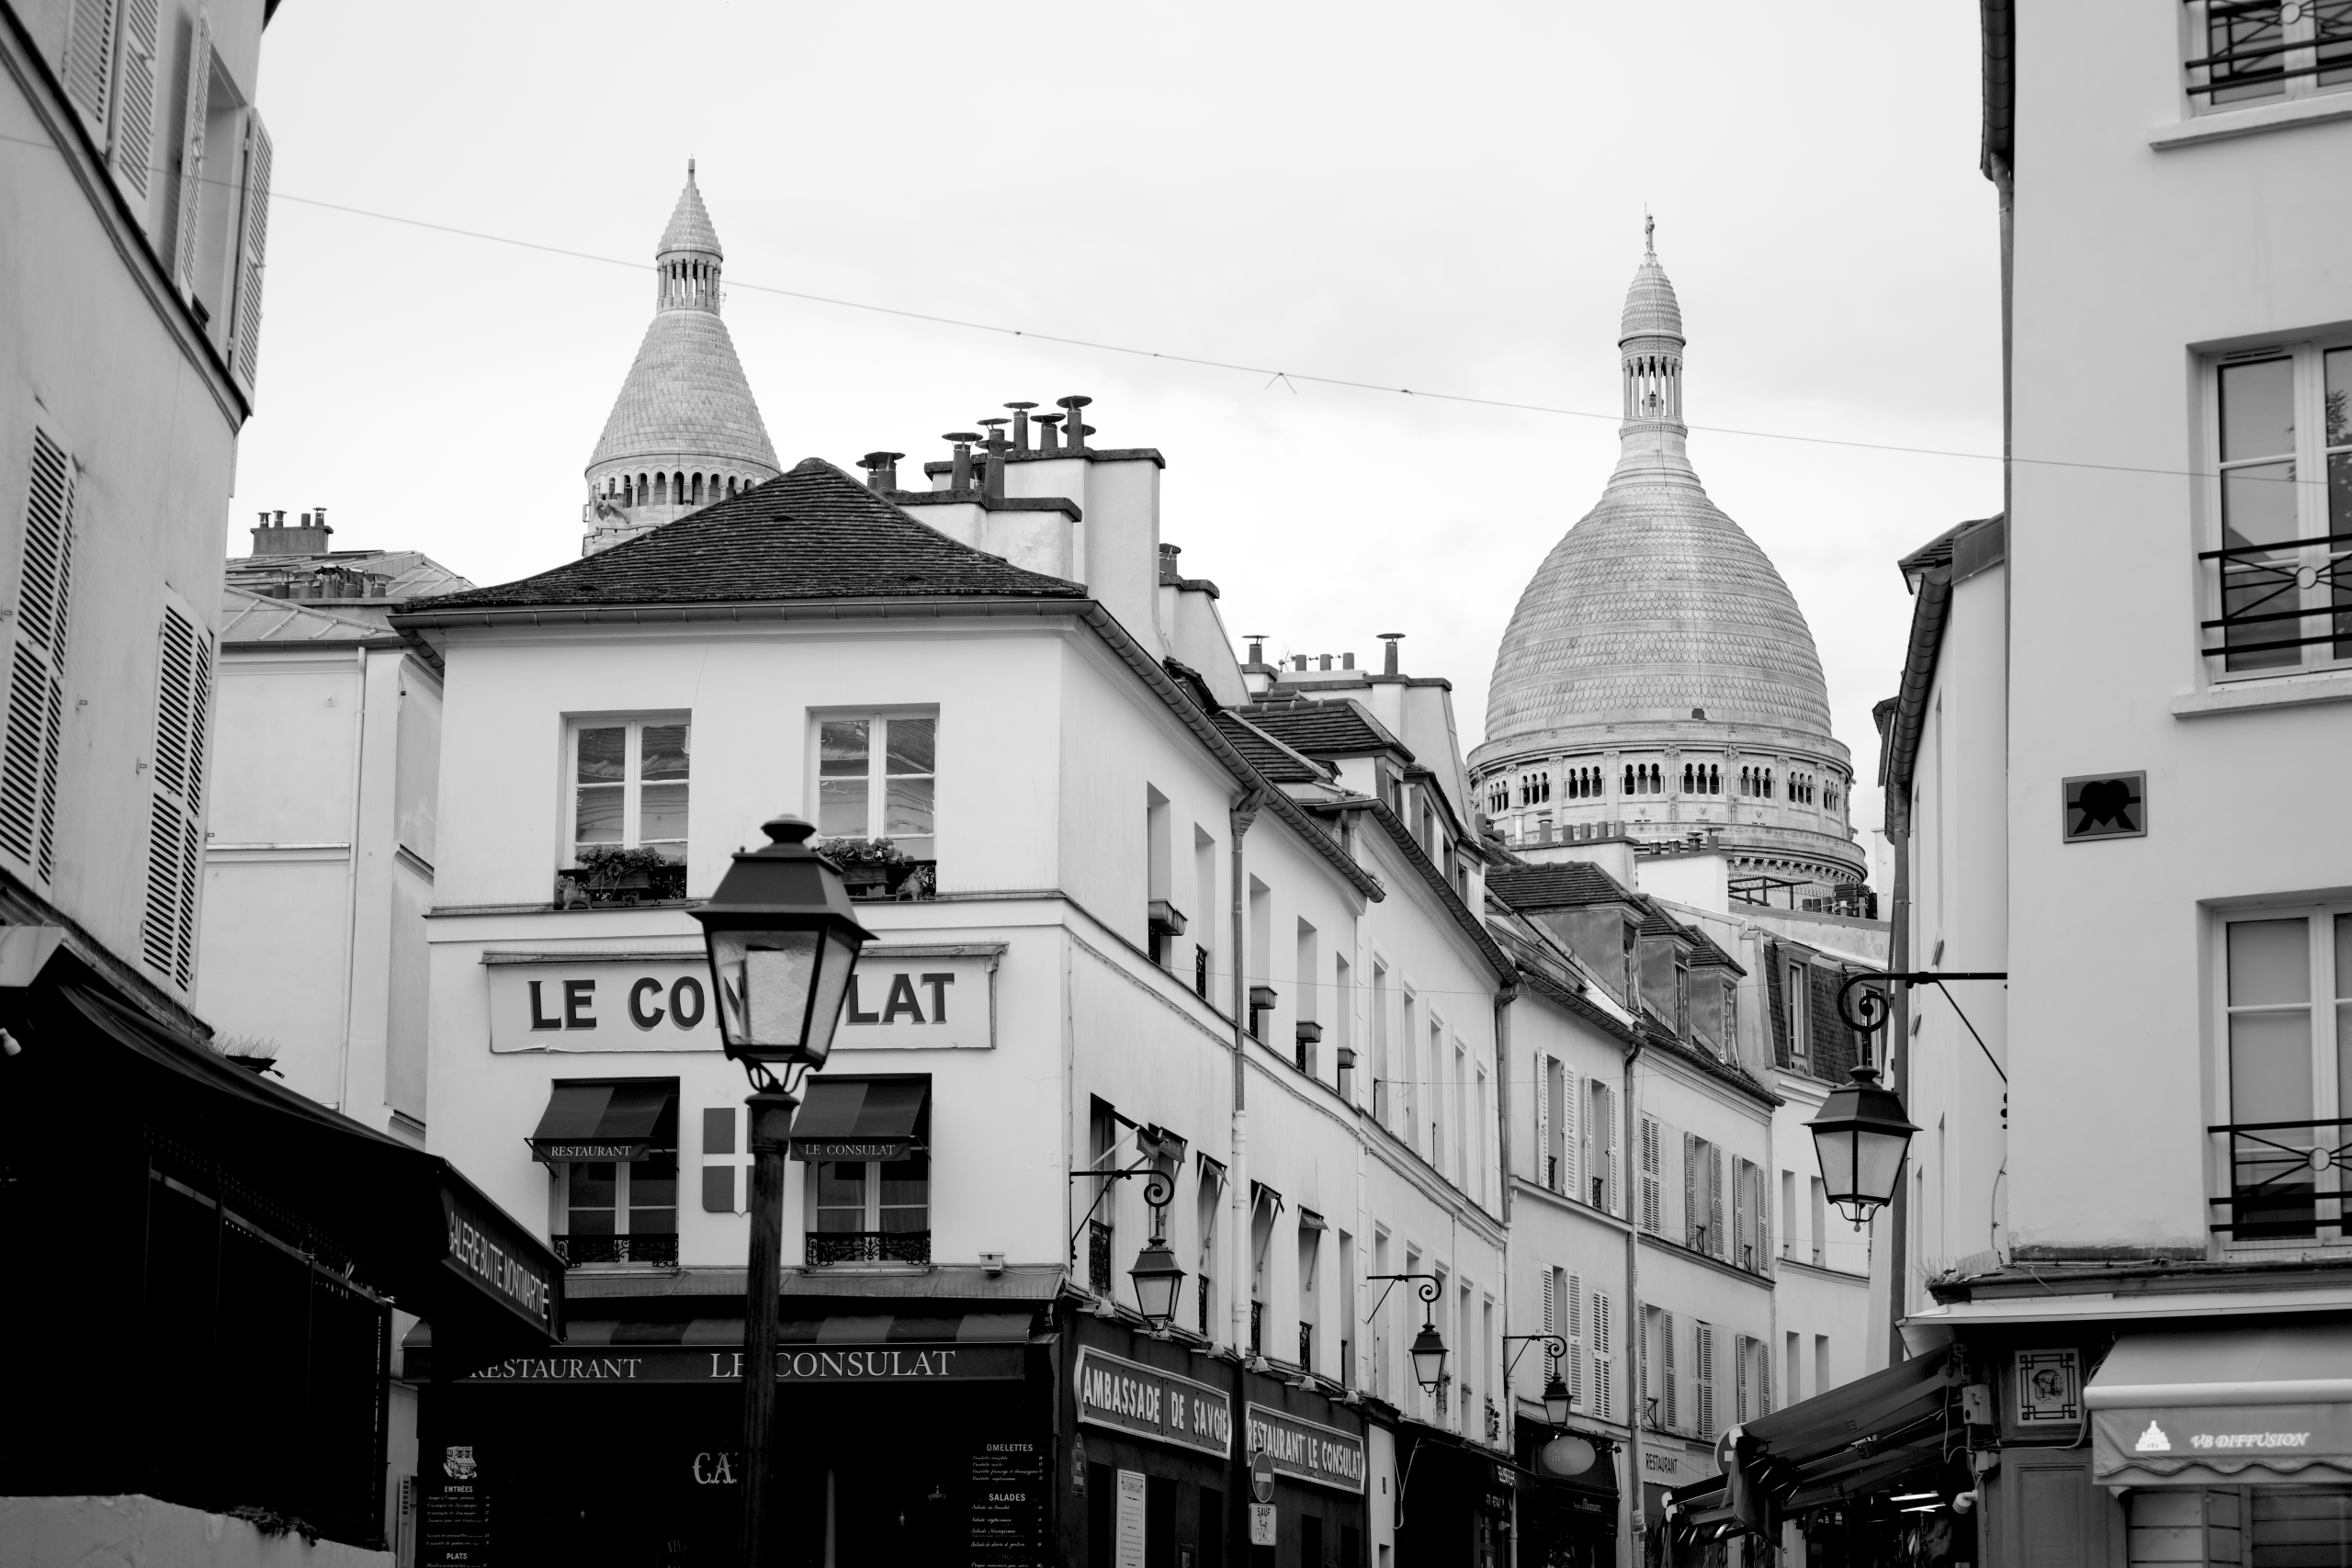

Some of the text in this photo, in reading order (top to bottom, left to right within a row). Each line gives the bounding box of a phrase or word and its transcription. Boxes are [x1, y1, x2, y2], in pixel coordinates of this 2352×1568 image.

[528, 973, 955, 1031] LE CONLAT
[551, 1145, 631, 1156] RESTAURANT
[805, 1145, 895, 1156] LE CONSULAT
[480, 1235, 503, 1289] BUTTE
[1083, 1366, 1227, 1444] AMBASSADE DE SAVOIE
[986, 1443, 1034, 1451] OMELETTES
[2190, 1432, 2311, 1449] VB DIFFUSION
[1247, 1418, 1362, 1481] RESTAURANT LE CONSULAT
[1645, 1452, 1677, 1474] RESTAURANT
[989, 1493, 1026, 1502] SALADES
[1257, 1506, 1271, 1517] SAUF
